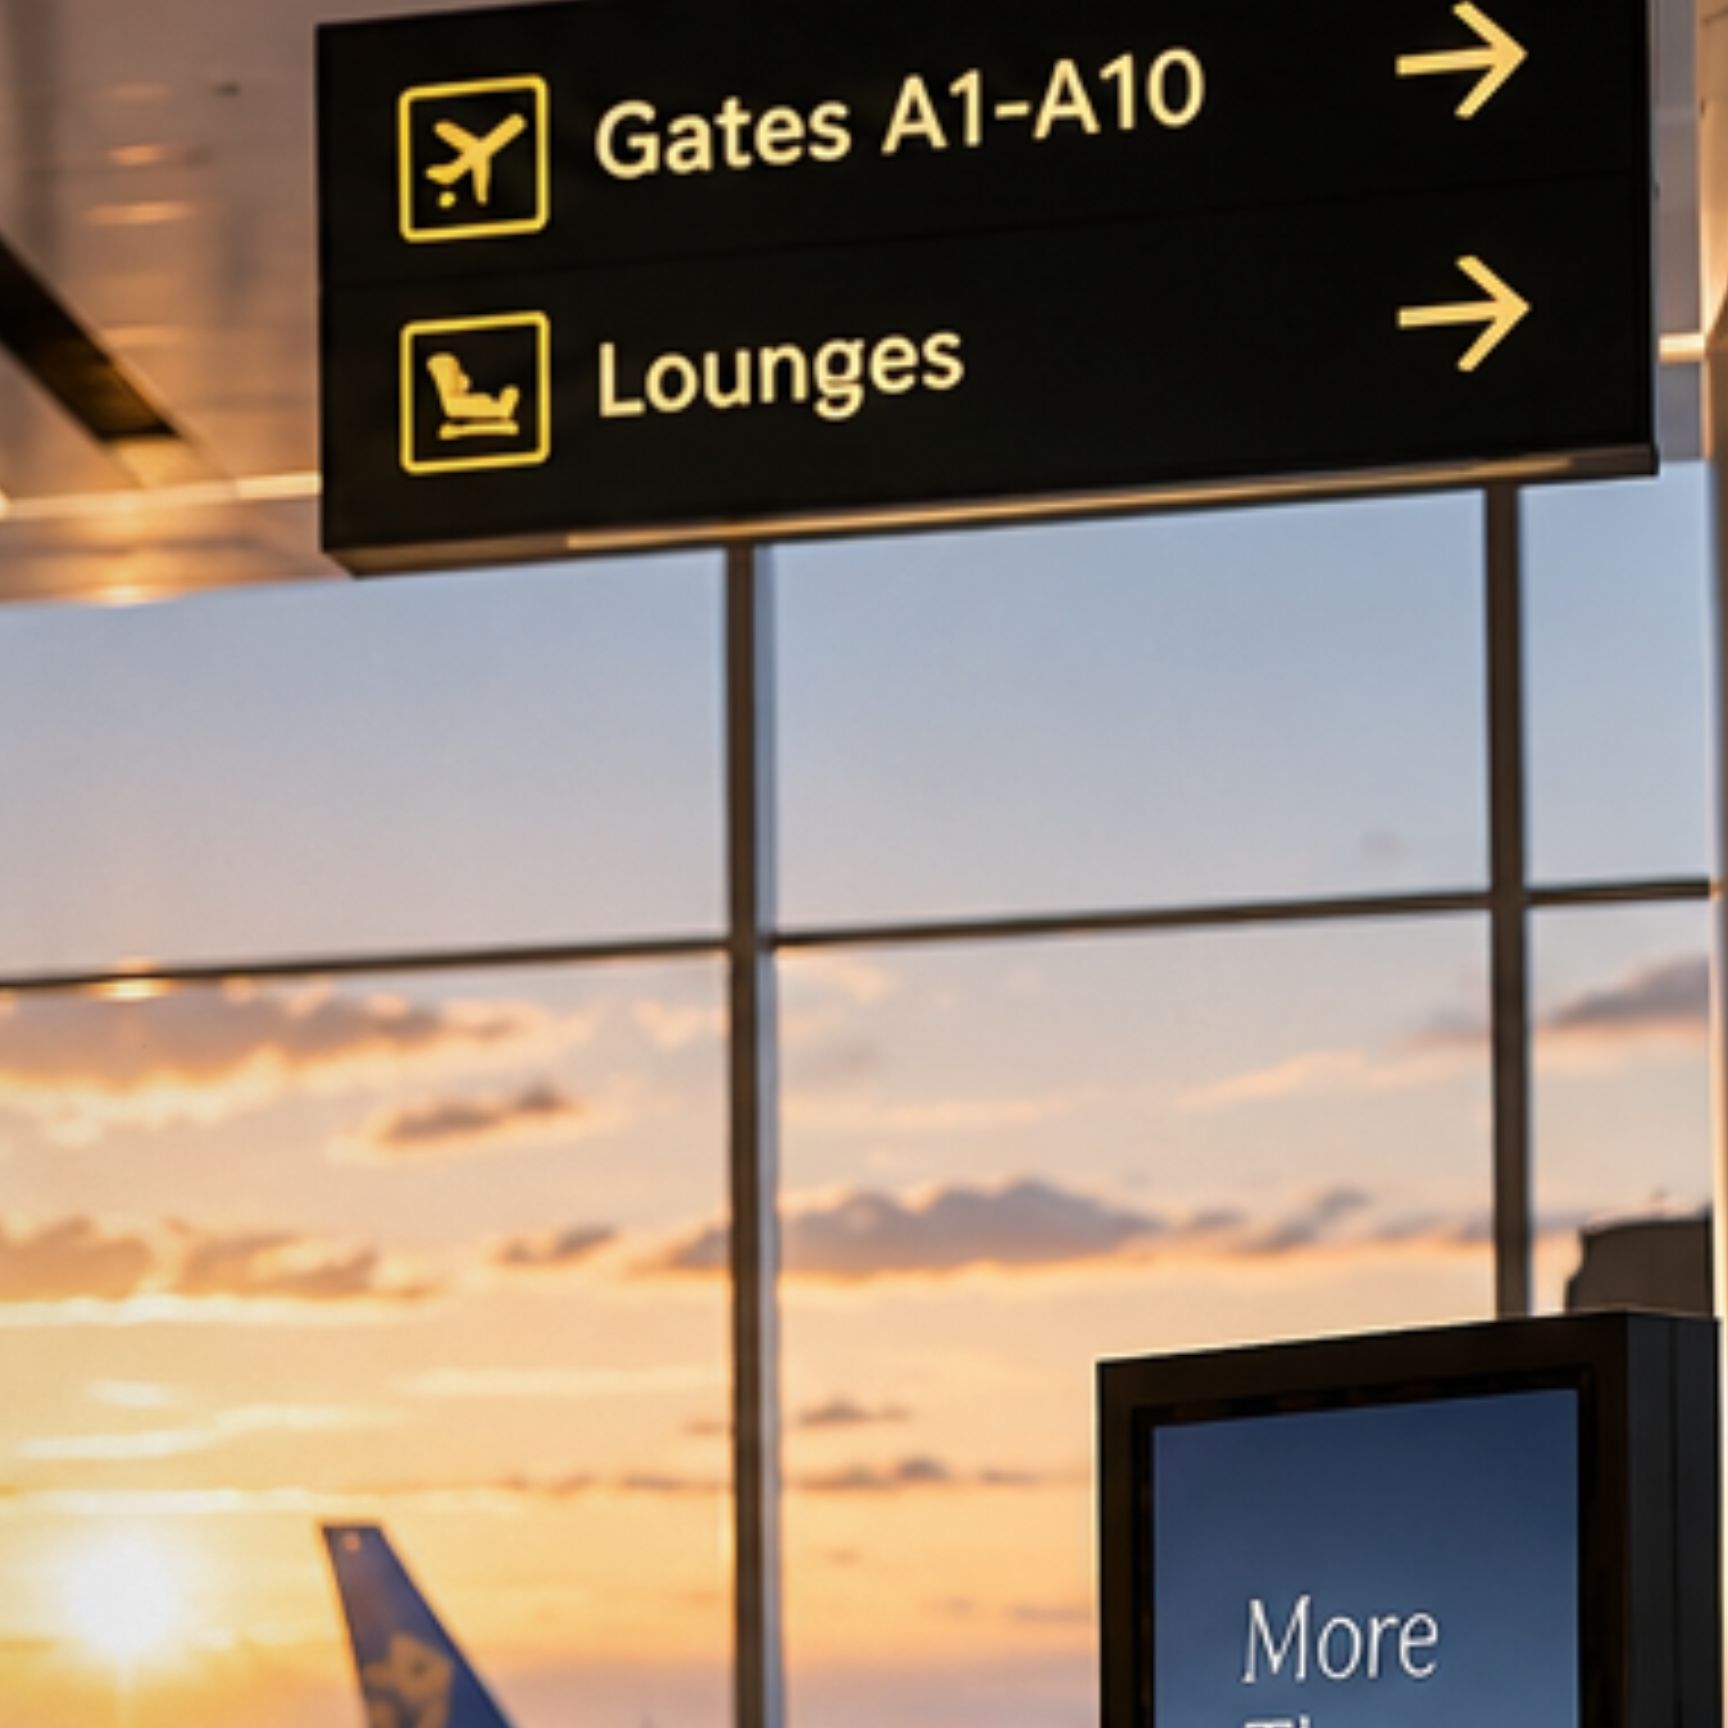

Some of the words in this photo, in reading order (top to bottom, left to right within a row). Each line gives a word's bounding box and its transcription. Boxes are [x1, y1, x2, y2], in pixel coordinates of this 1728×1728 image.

[594, 95, 852, 181] Gates
[881, 48, 1205, 155] A1-A10
[597, 330, 965, 421] Lounges
[1240, 1594, 1440, 1685] More
